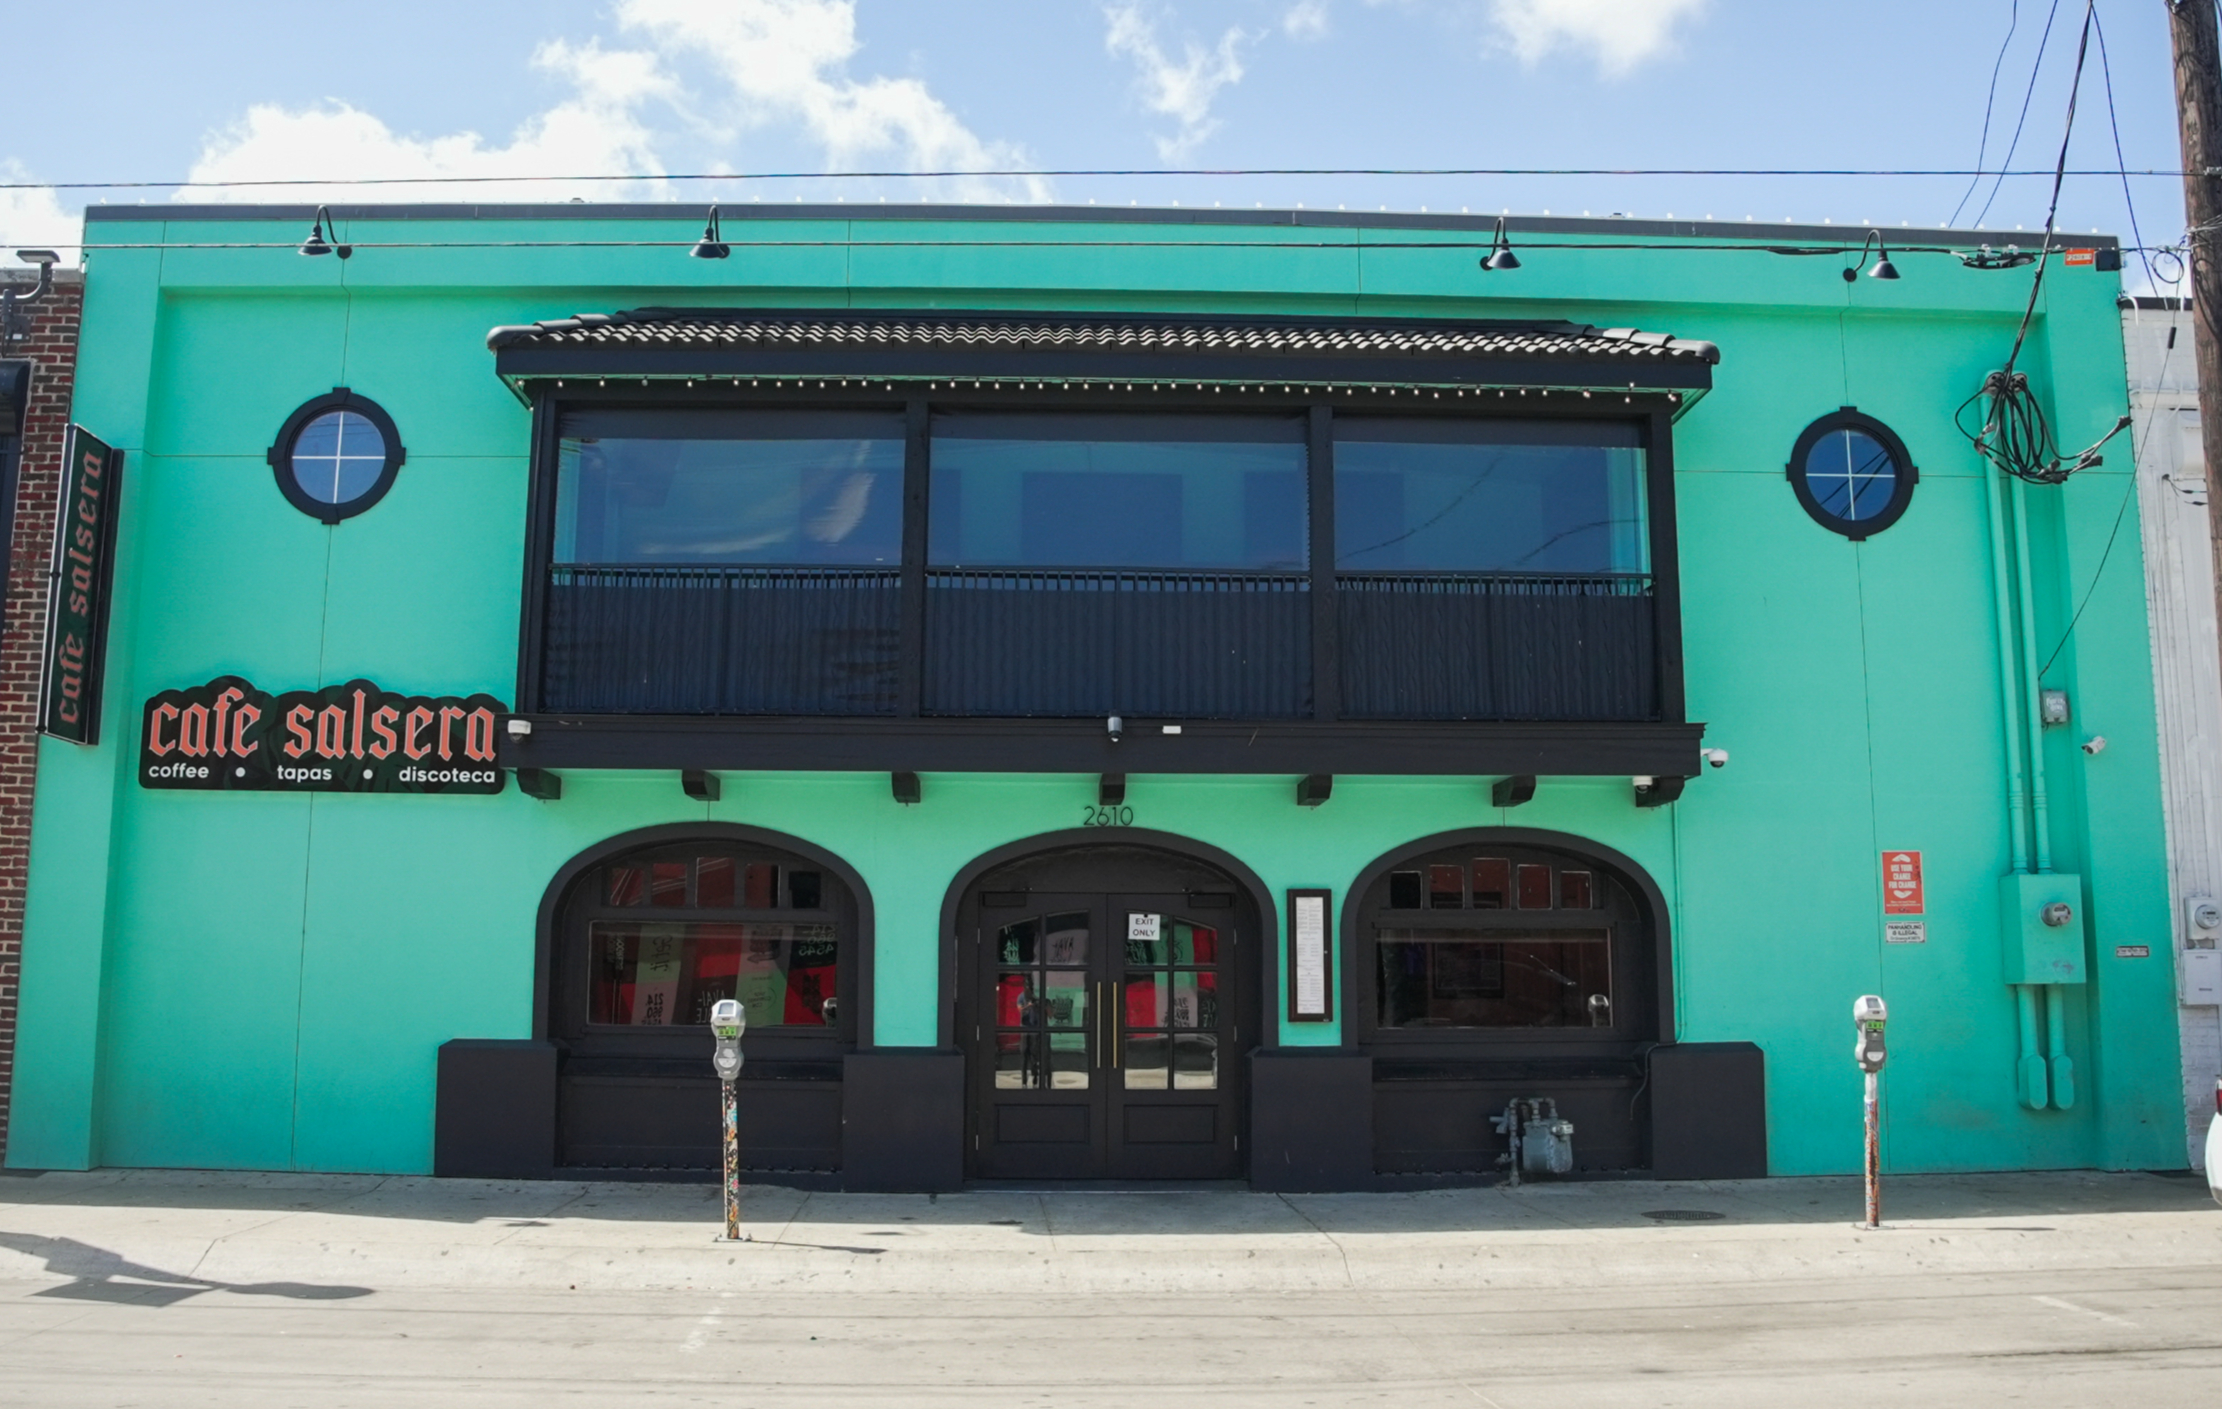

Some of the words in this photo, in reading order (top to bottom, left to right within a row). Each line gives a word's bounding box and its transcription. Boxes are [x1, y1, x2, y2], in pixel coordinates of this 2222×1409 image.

[68, 451, 102, 617] salsera
[59, 632, 84, 724] cafe
[149, 686, 262, 758] cafe
[283, 688, 497, 762] salsera
[148, 762, 210, 778] coffee
[277, 764, 333, 783] tapas
[399, 766, 496, 783] discoteca
[1083, 805, 1134, 827] 2610
[1888, 881, 1898, 889] FOR
[1898, 881, 1917, 889] CHANGE
[1132, 929, 1156, 937] ONLY
